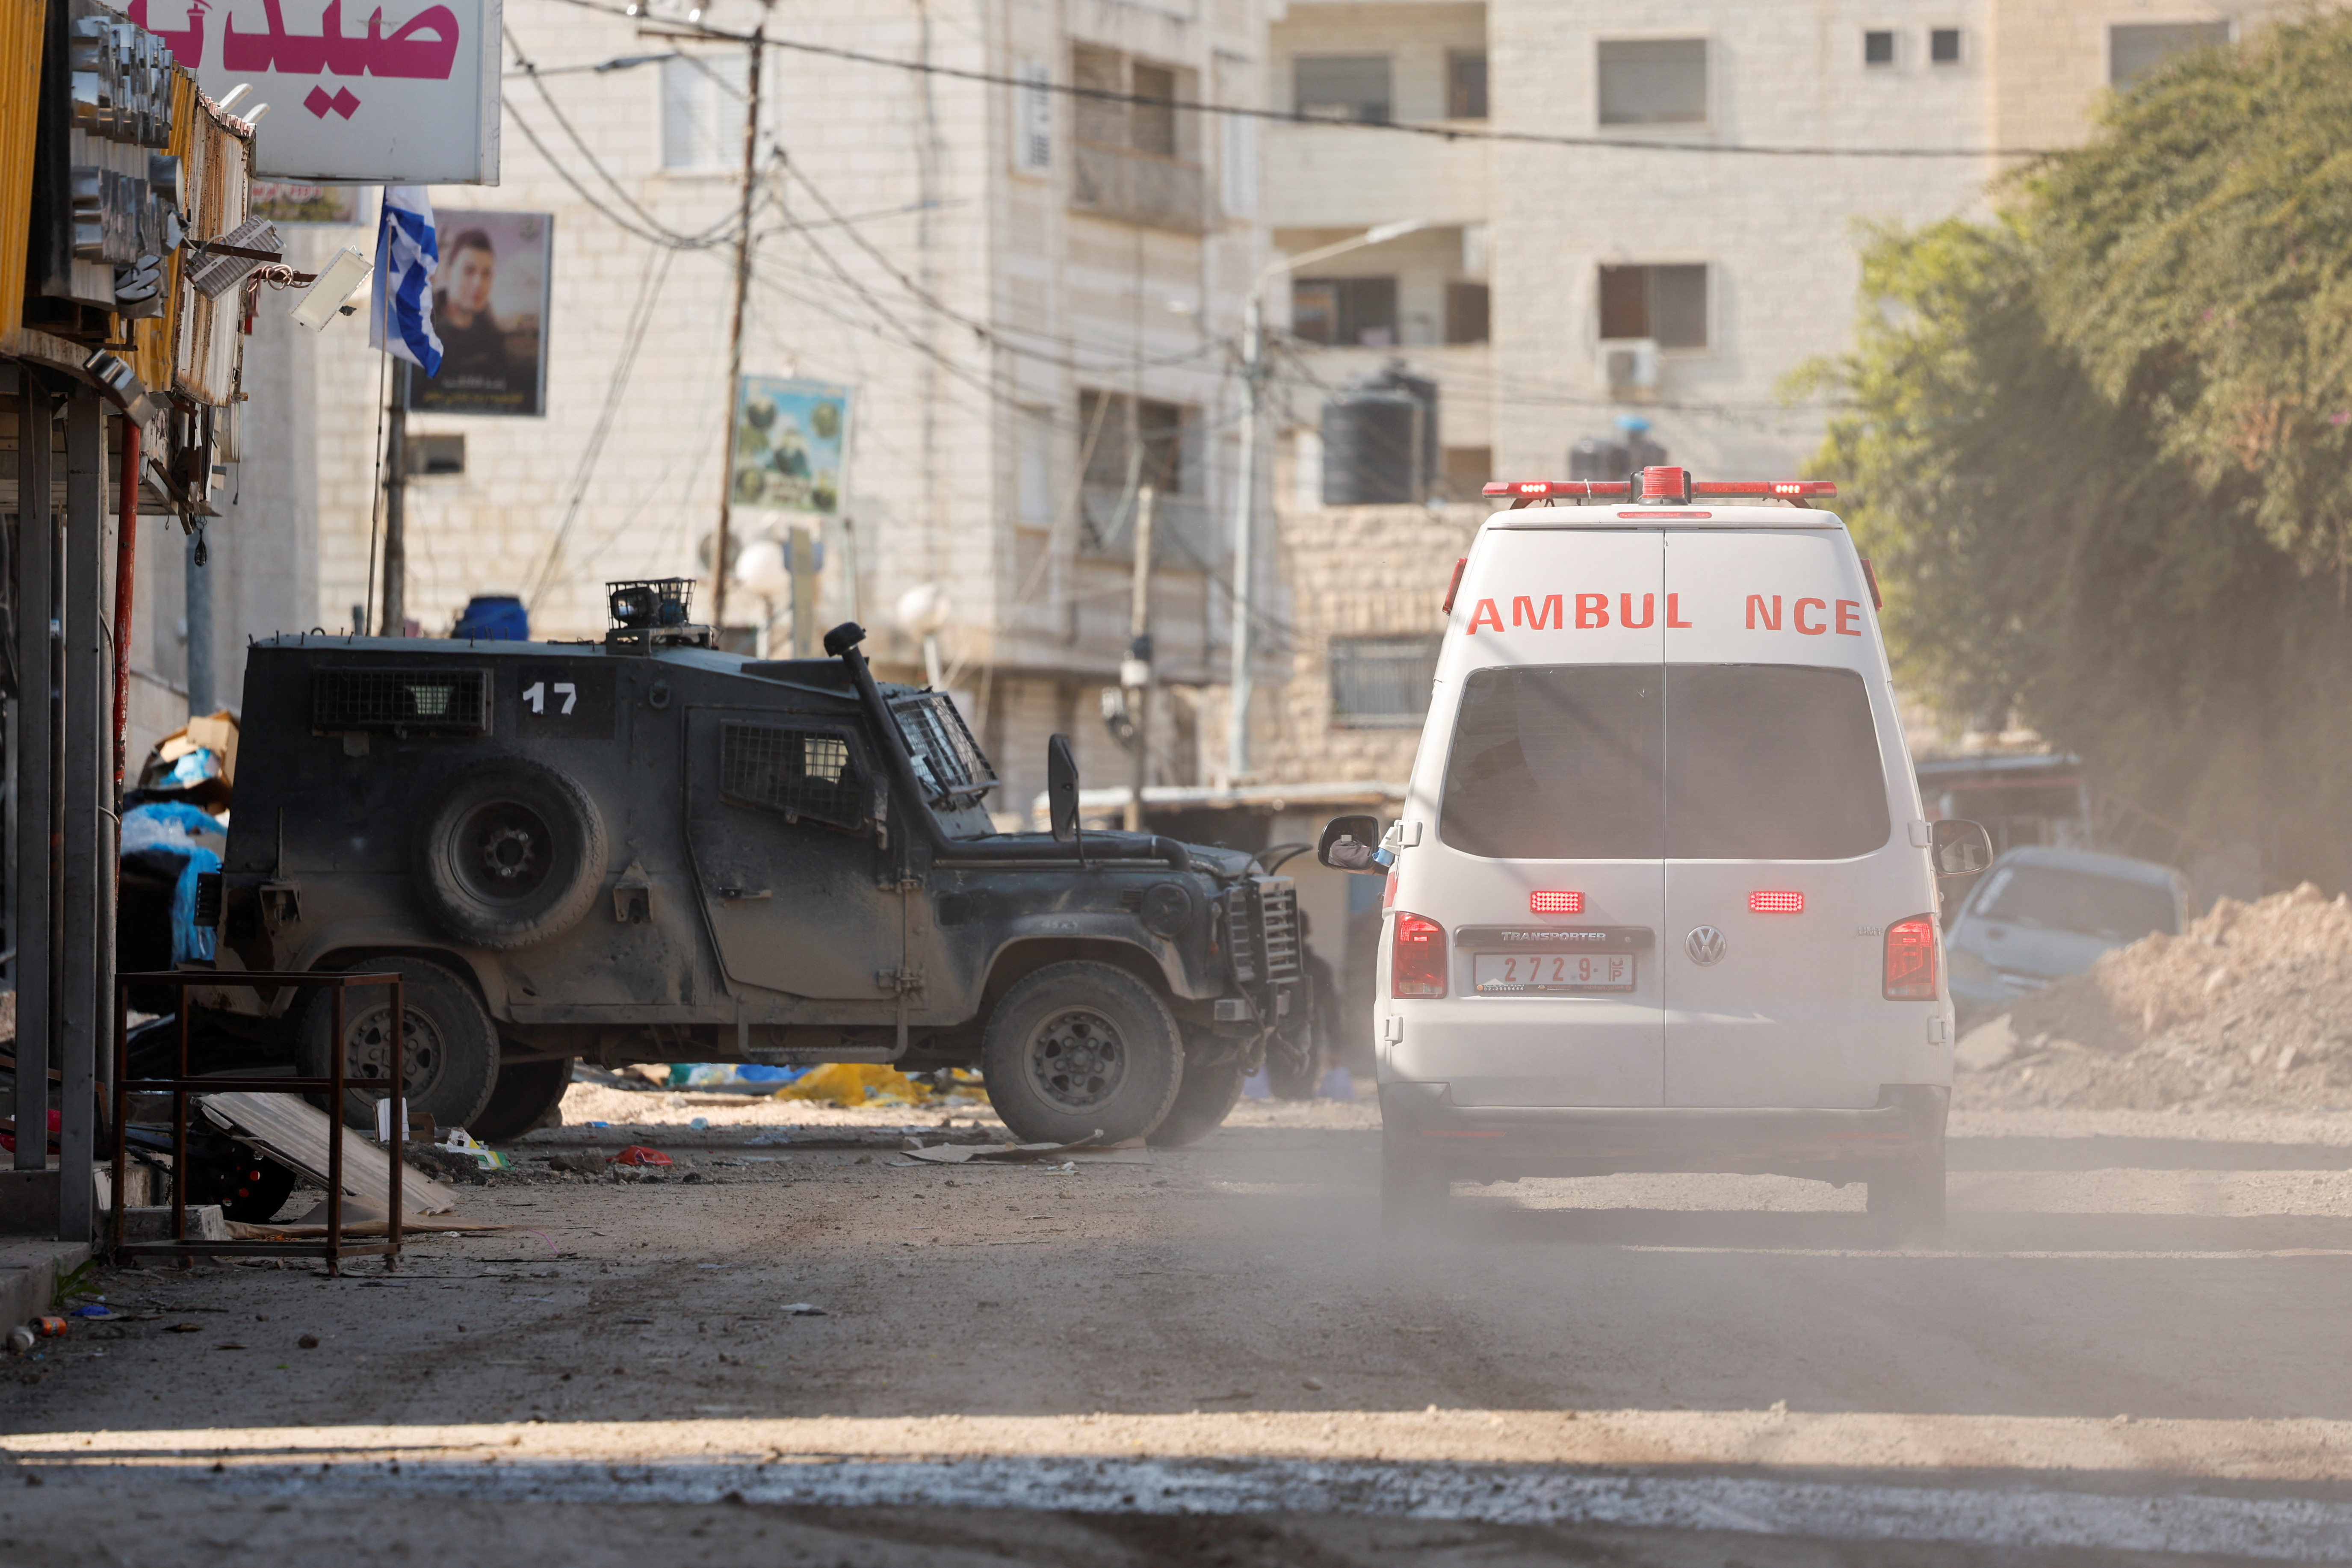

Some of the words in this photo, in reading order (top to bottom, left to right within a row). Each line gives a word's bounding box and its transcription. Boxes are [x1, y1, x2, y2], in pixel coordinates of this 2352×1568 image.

[1745, 594, 1862, 636] NCE
[523, 682, 577, 715] 17
[1501, 932, 1606, 941] TRANSPORTER
[1505, 957, 1590, 981] 2729
[1612, 970, 1622, 982] P
